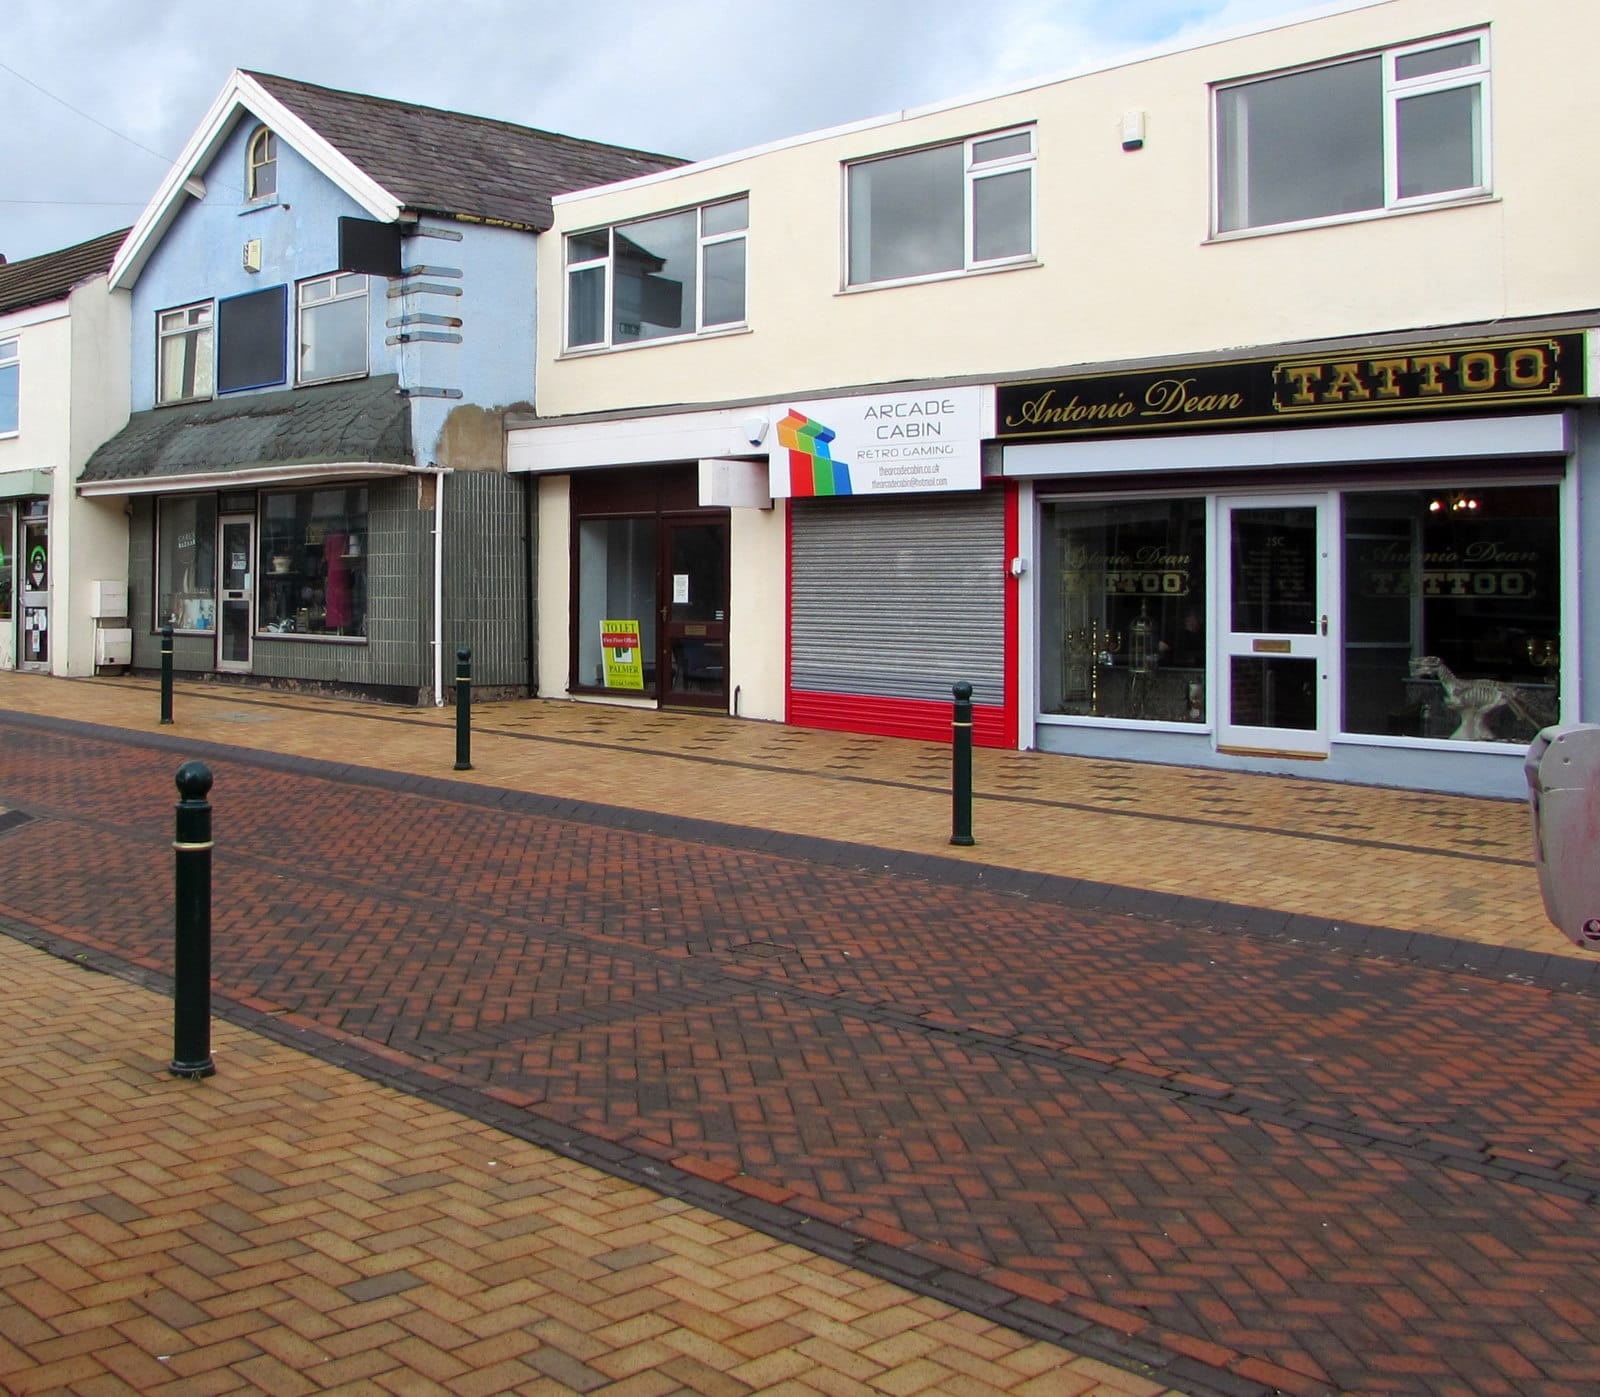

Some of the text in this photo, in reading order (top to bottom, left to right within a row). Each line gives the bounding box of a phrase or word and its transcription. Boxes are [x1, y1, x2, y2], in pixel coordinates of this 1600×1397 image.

[1286, 348, 1549, 404] TATTOO
[863, 399, 955, 421] ARCADE
[1005, 377, 1244, 428] Antonio Dean
[876, 421, 942, 441] CABIN
[856, 444, 954, 461] RETRO GAMING
[878, 463, 941, 477] thearcadecabin.co.uk
[871, 476, 949, 490] thearcadecabin@hotmail.com
[1133, 544, 1192, 569] Dean
[1463, 540, 1538, 562] Dean
[1370, 572, 1526, 595] TATTOO
[606, 623, 636, 633] TO LET
[608, 664, 640, 674] PALMER
